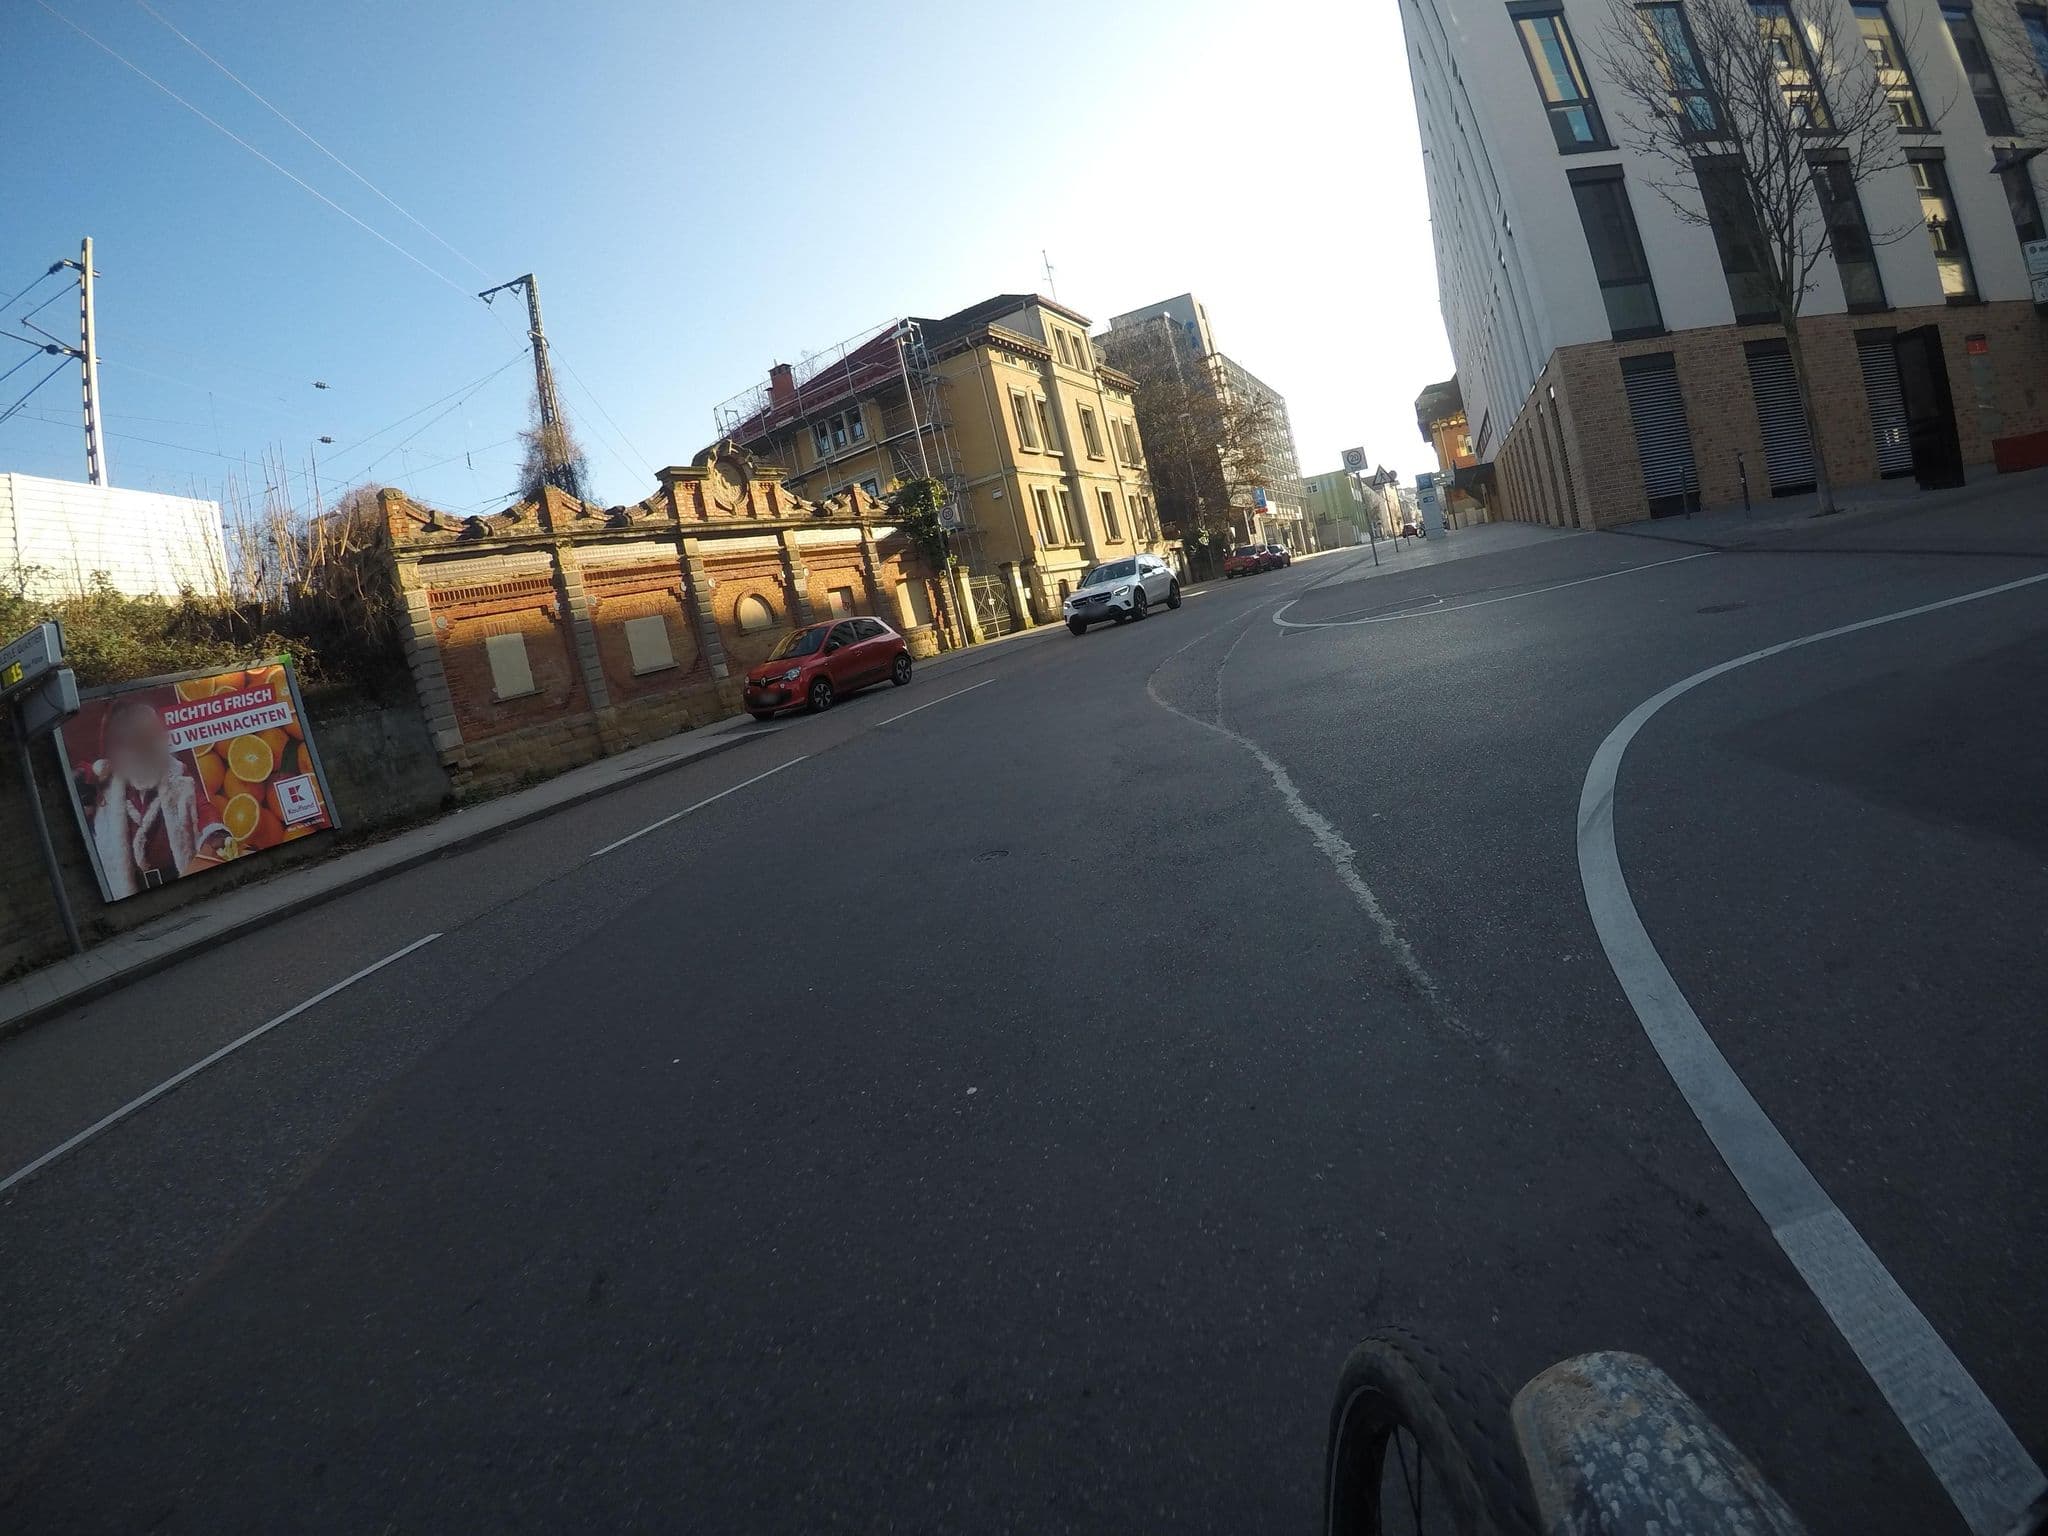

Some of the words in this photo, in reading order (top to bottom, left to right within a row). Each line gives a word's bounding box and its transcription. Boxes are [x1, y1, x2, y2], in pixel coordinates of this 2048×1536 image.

[164, 701, 222, 725] RICHTIG
[223, 688, 273, 711] FRISCH
[184, 707, 287, 742] WEIHNACHTEN
